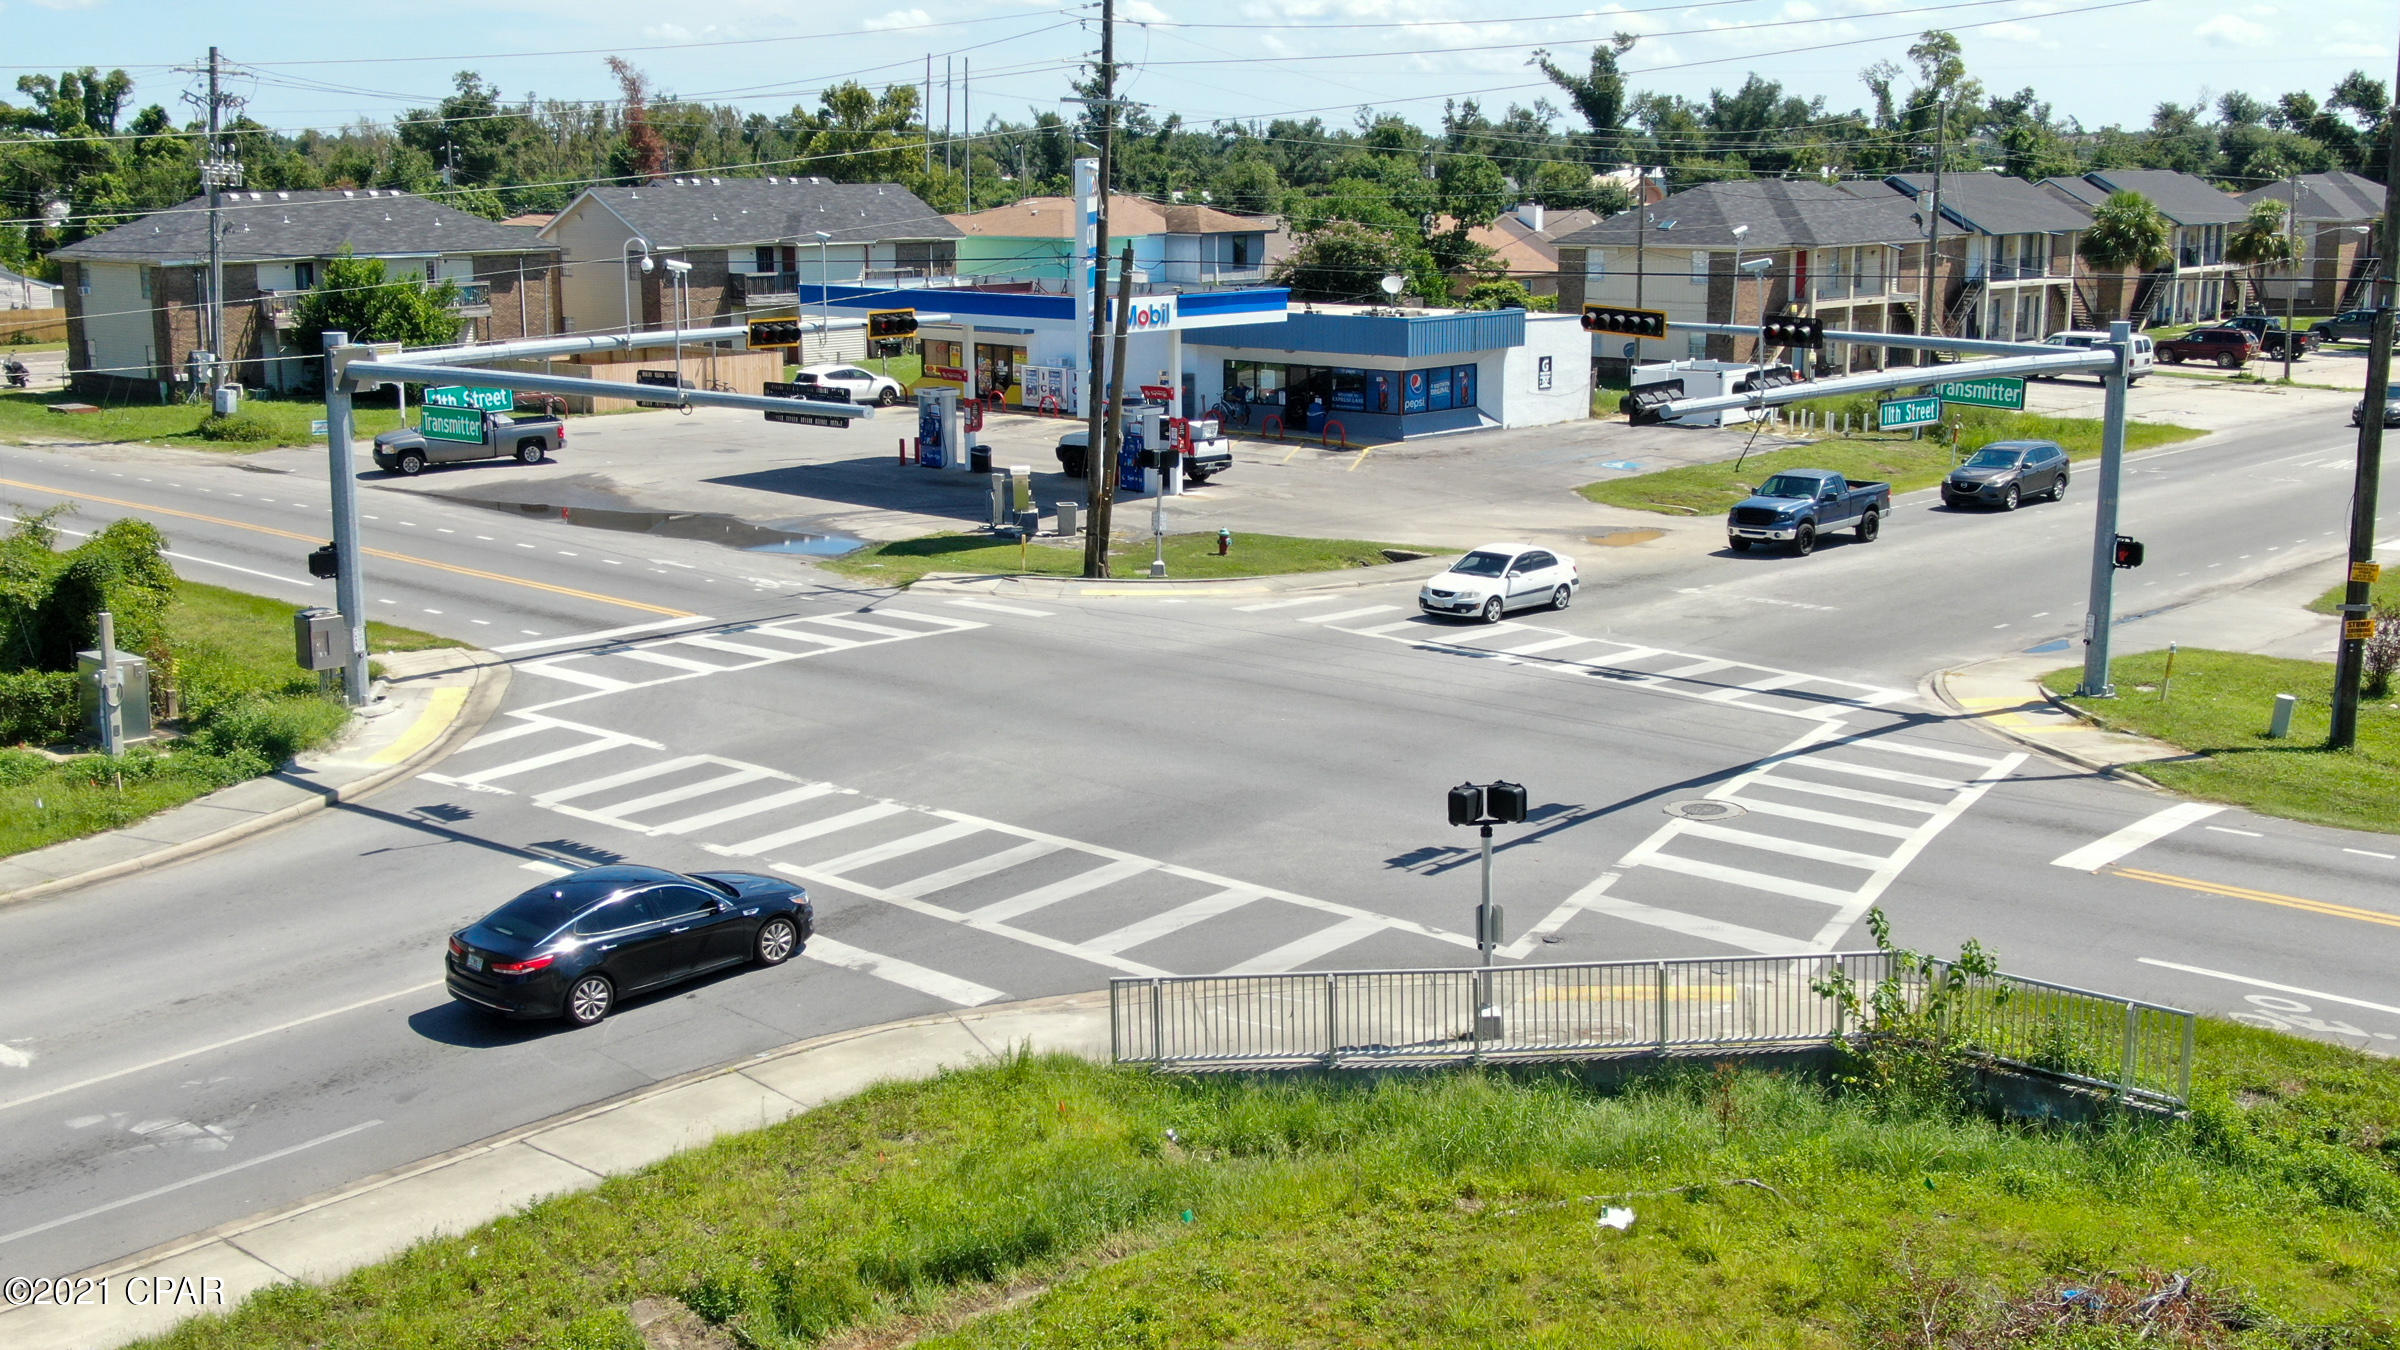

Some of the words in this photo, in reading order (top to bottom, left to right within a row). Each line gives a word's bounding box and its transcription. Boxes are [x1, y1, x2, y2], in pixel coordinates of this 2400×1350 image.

[1404, 397, 1425, 411] pepsi
[1884, 405, 1901, 425] 11th
[1905, 400, 1935, 422] Street
[422, 411, 481, 437] Transmitter
